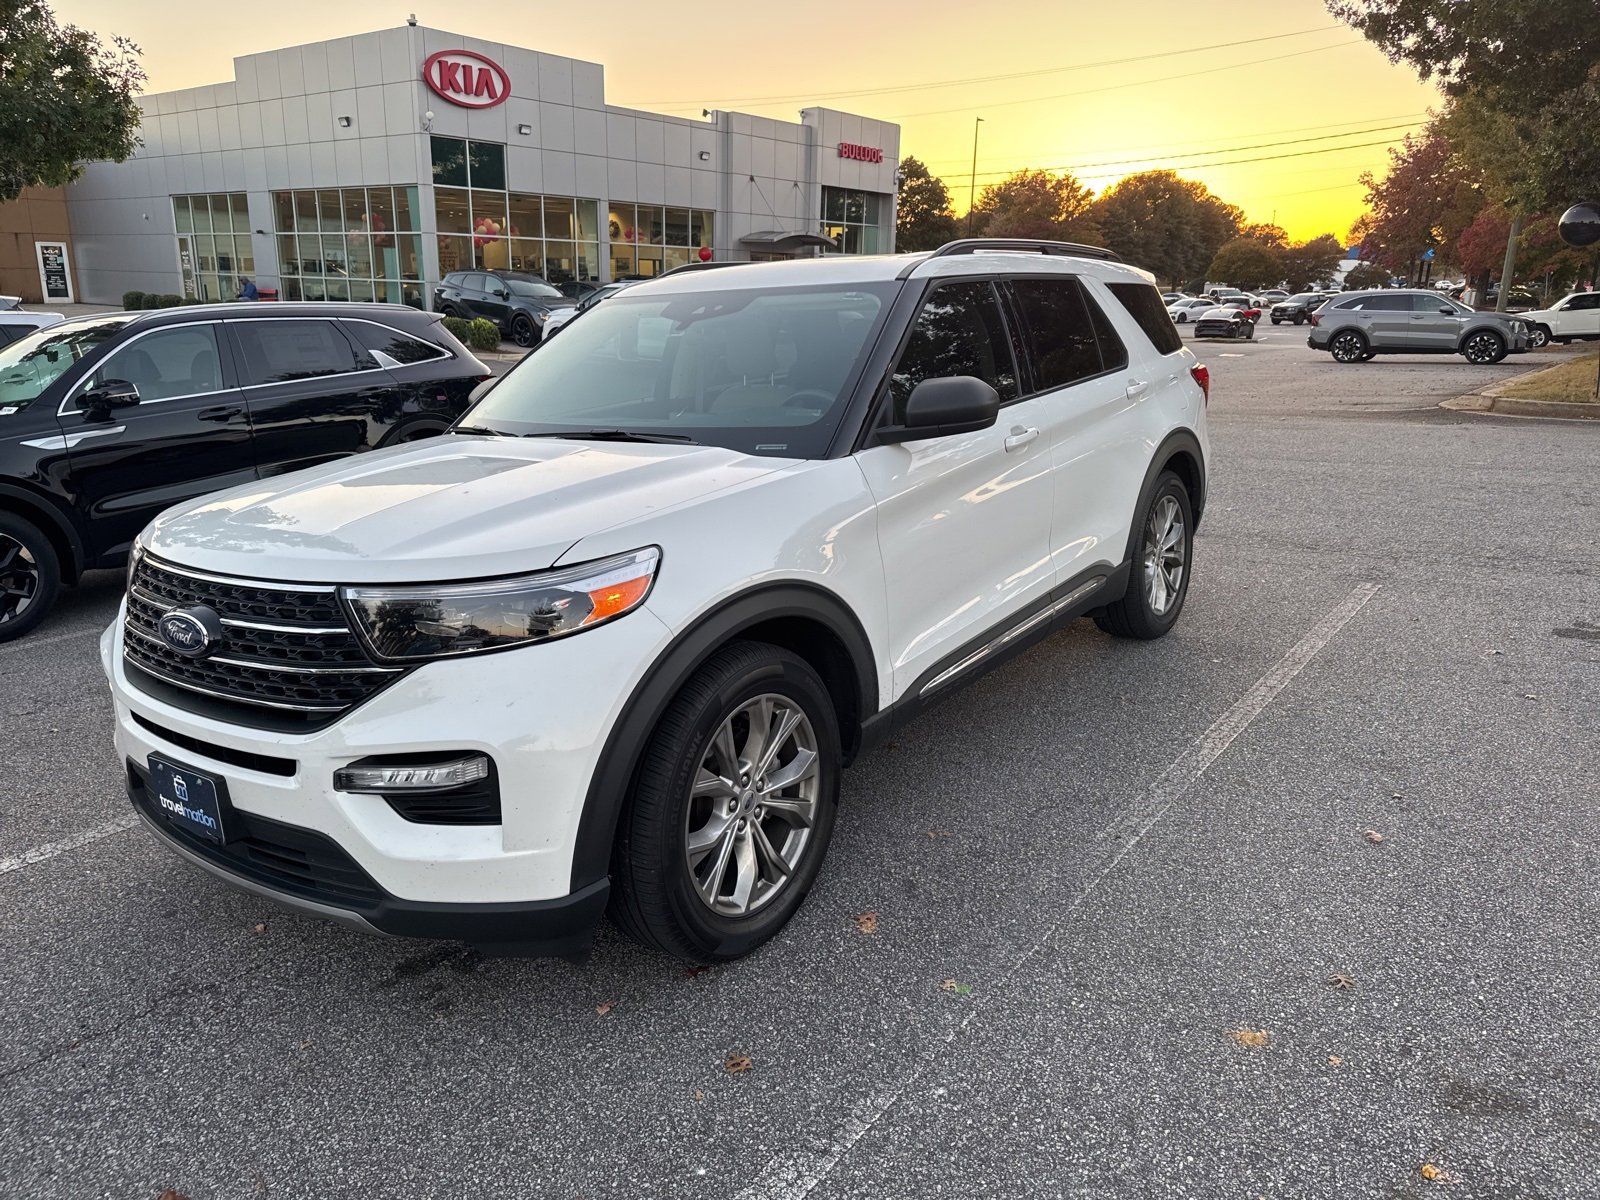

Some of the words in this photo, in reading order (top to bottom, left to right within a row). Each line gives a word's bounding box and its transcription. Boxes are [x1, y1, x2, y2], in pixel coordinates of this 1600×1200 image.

[437, 60, 497, 99] KIA
[839, 143, 883, 163] BULLDOG
[167, 620, 193, 645] Ford
[159, 793, 217, 829] travelmotion
